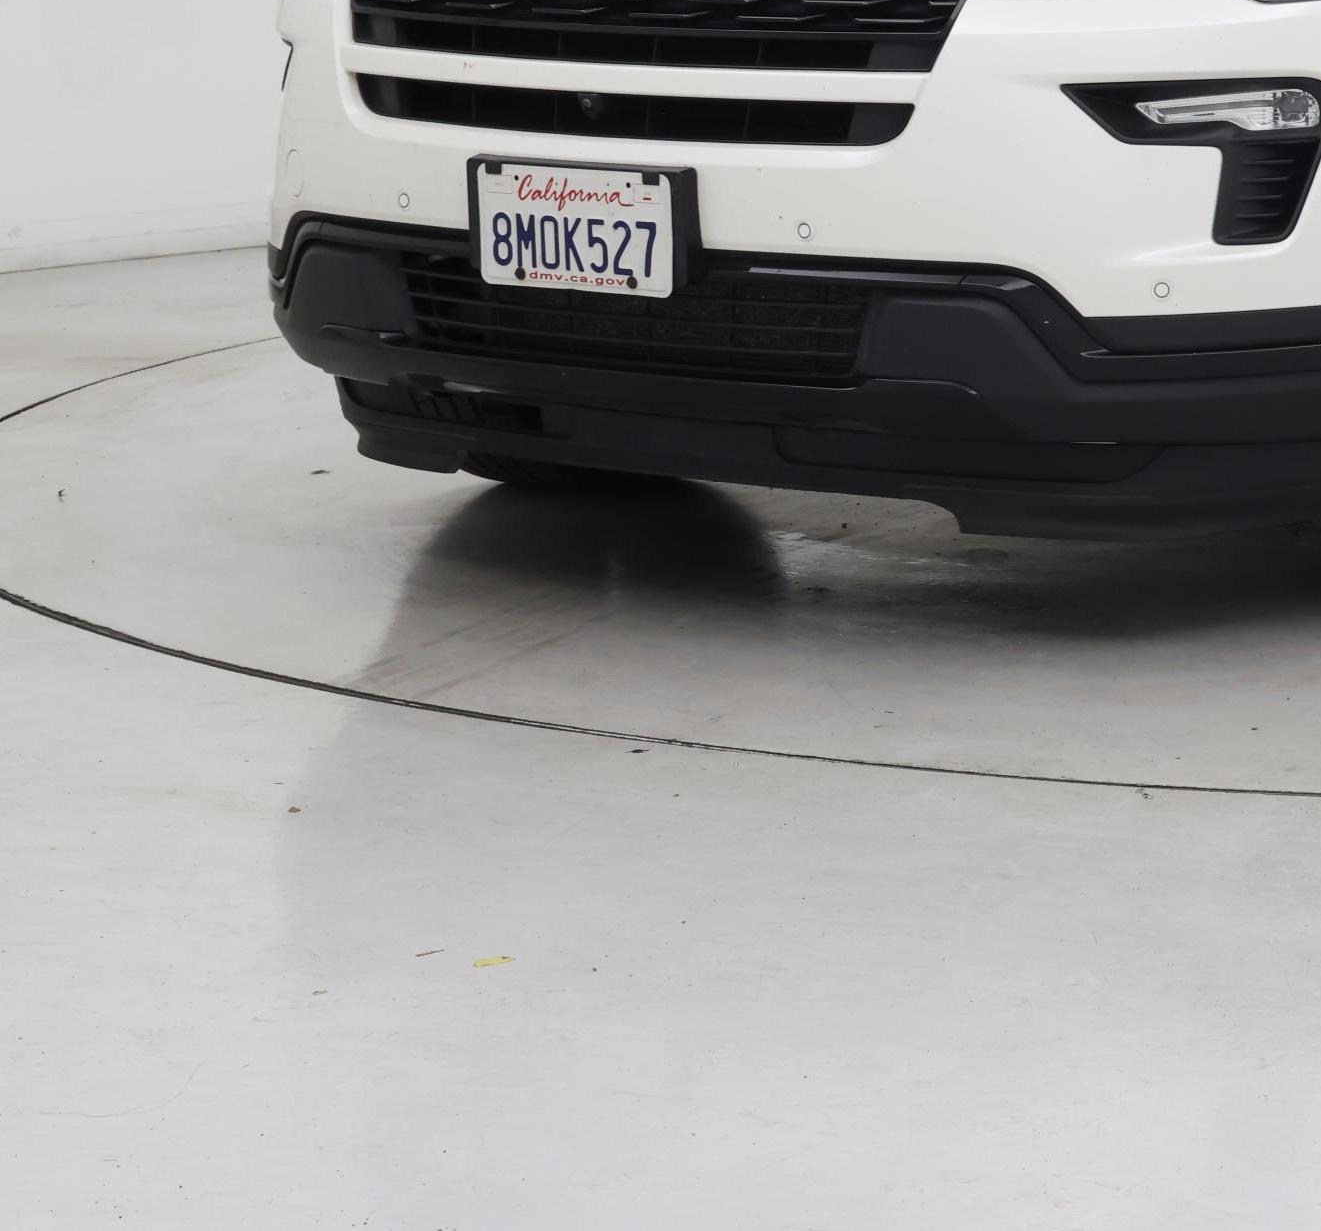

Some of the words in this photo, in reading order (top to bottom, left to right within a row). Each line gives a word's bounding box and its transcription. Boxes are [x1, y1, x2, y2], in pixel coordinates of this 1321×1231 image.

[517, 174, 635, 211] California
[492, 211, 657, 278] 8MOK527
[529, 270, 626, 287] dmv.ca.gov
